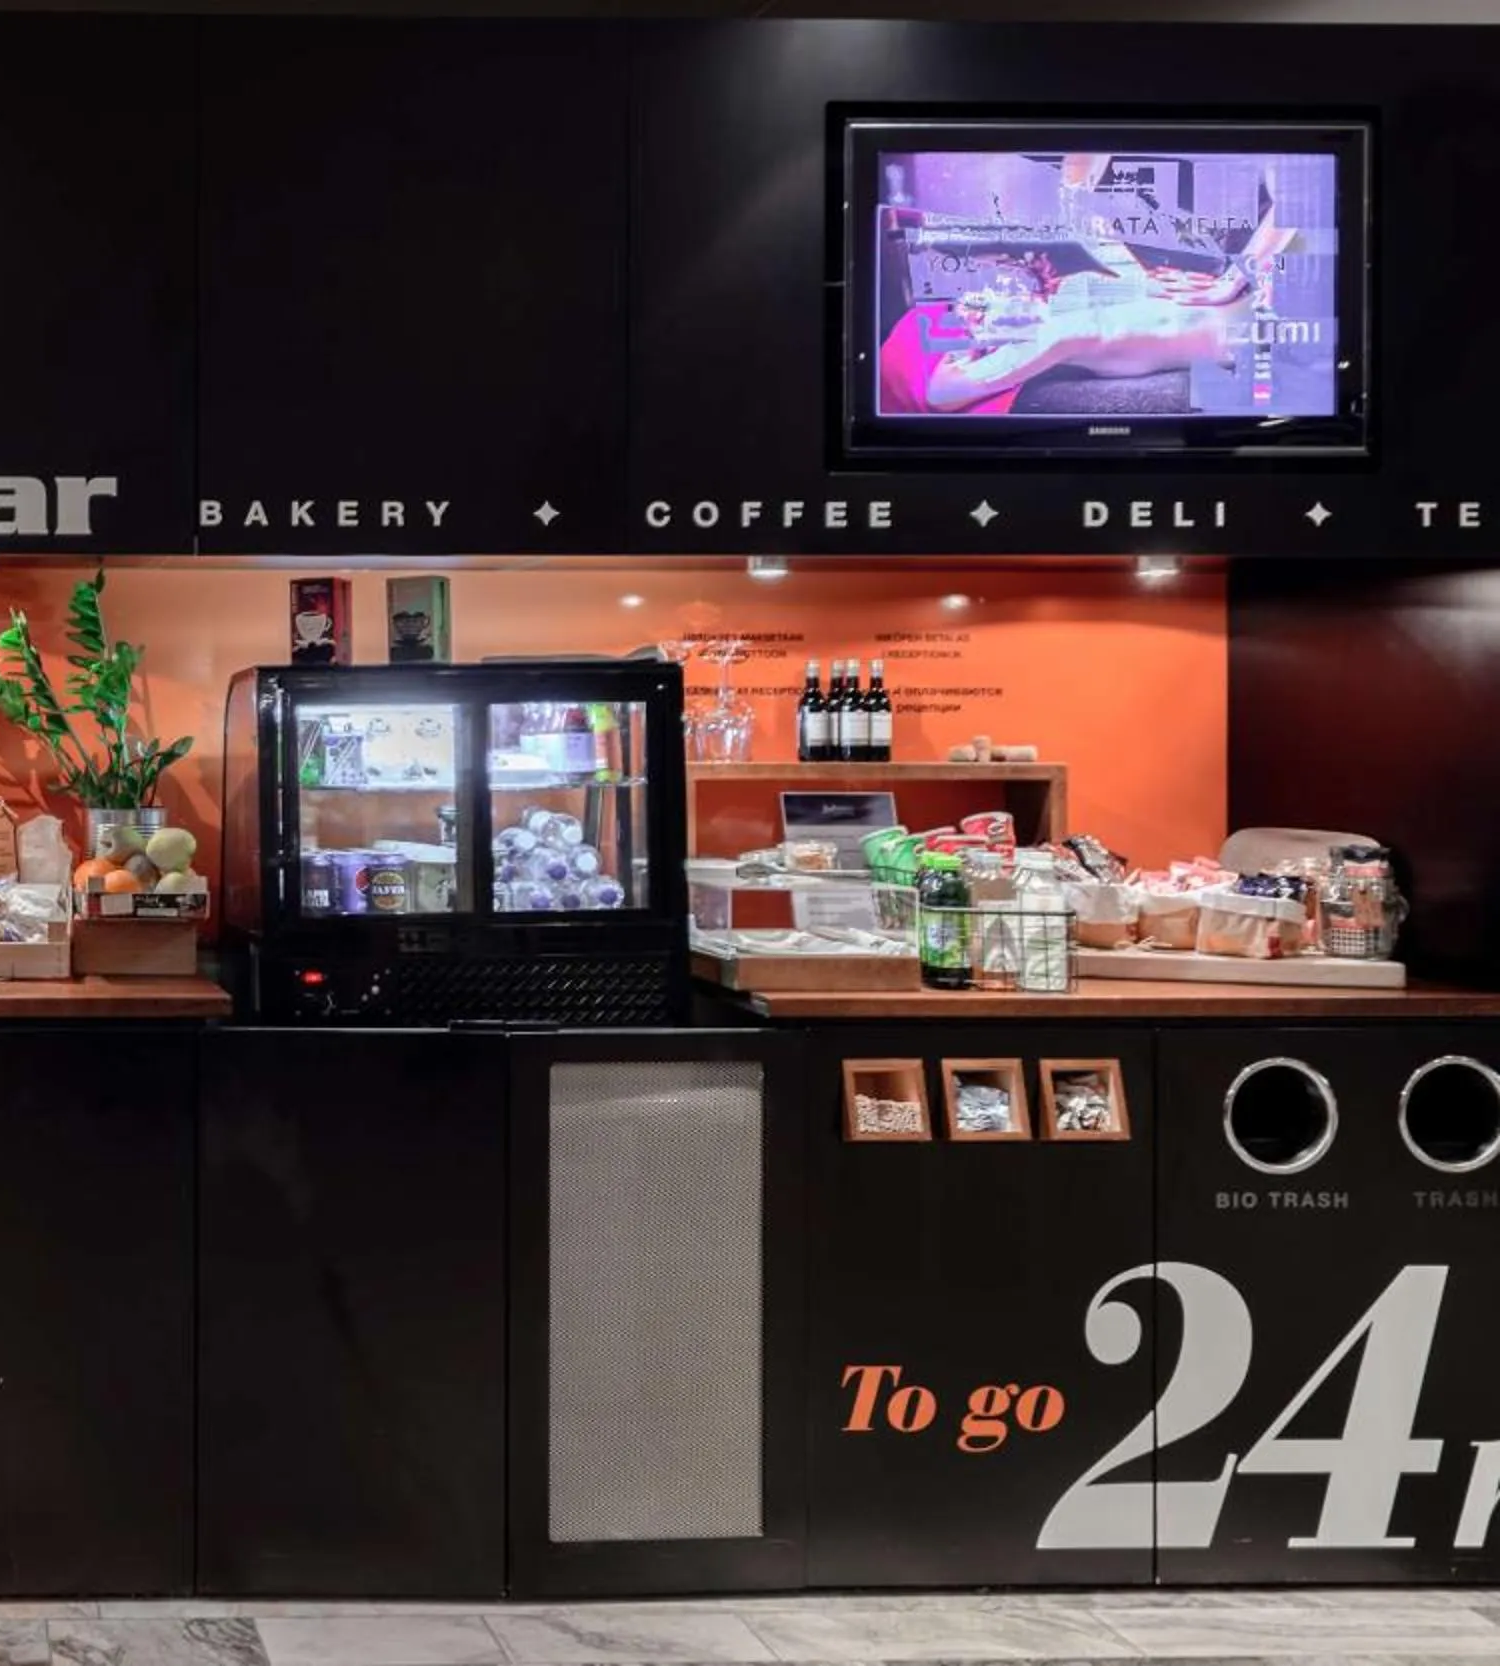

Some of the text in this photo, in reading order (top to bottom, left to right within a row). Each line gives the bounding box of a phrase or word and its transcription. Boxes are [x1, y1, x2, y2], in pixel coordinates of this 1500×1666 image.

[199, 499, 1481, 529] BAKERY COFFEE DELI TE
[751, 687, 805, 696] RECEPTIO
[1215, 1191, 1349, 1209] BIO TRASH
[841, 1364, 1066, 1453] To go
